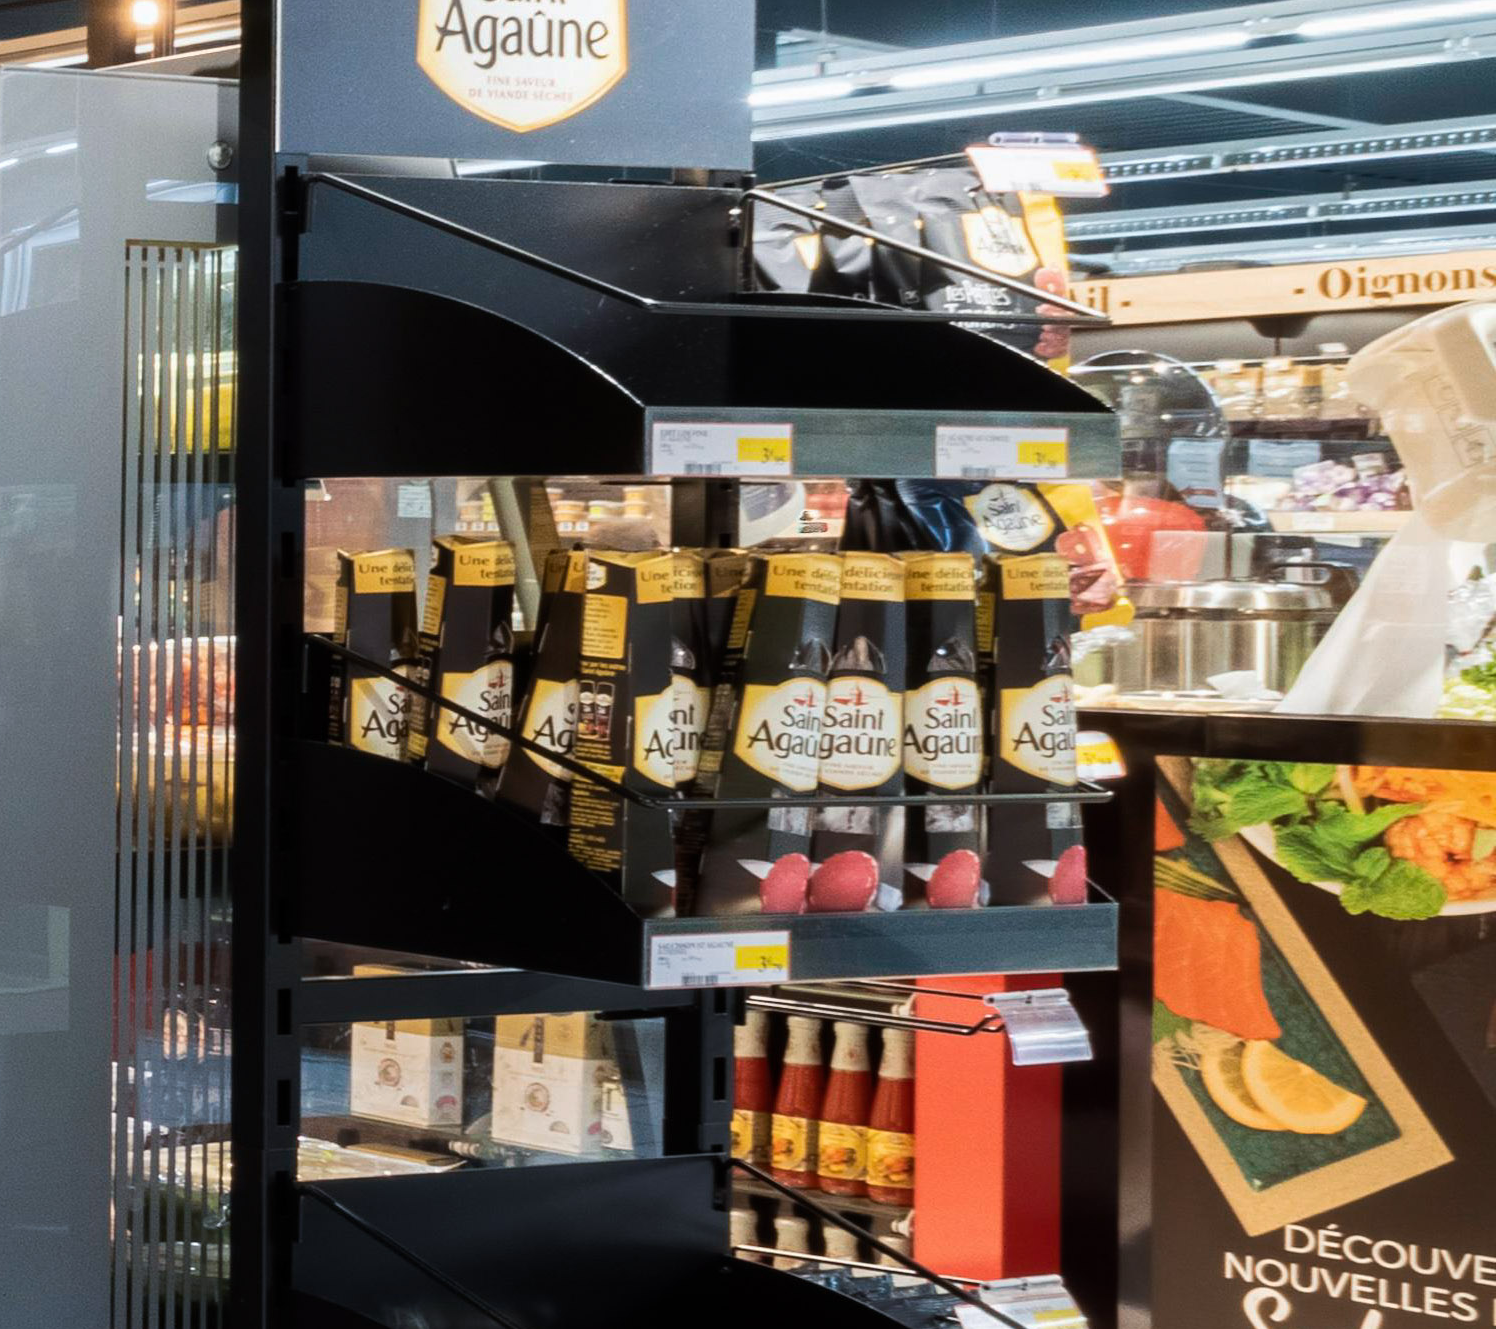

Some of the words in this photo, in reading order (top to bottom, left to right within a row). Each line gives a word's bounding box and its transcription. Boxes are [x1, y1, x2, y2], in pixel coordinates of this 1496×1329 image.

[1318, 266, 1496, 300] Oignons
[773, 565, 807, 578] Une
[822, 705, 885, 732] Saint
[1284, 1223, 1496, 1288] DÉCOUVE
[1224, 1252, 1479, 1322] NOUVELLES
